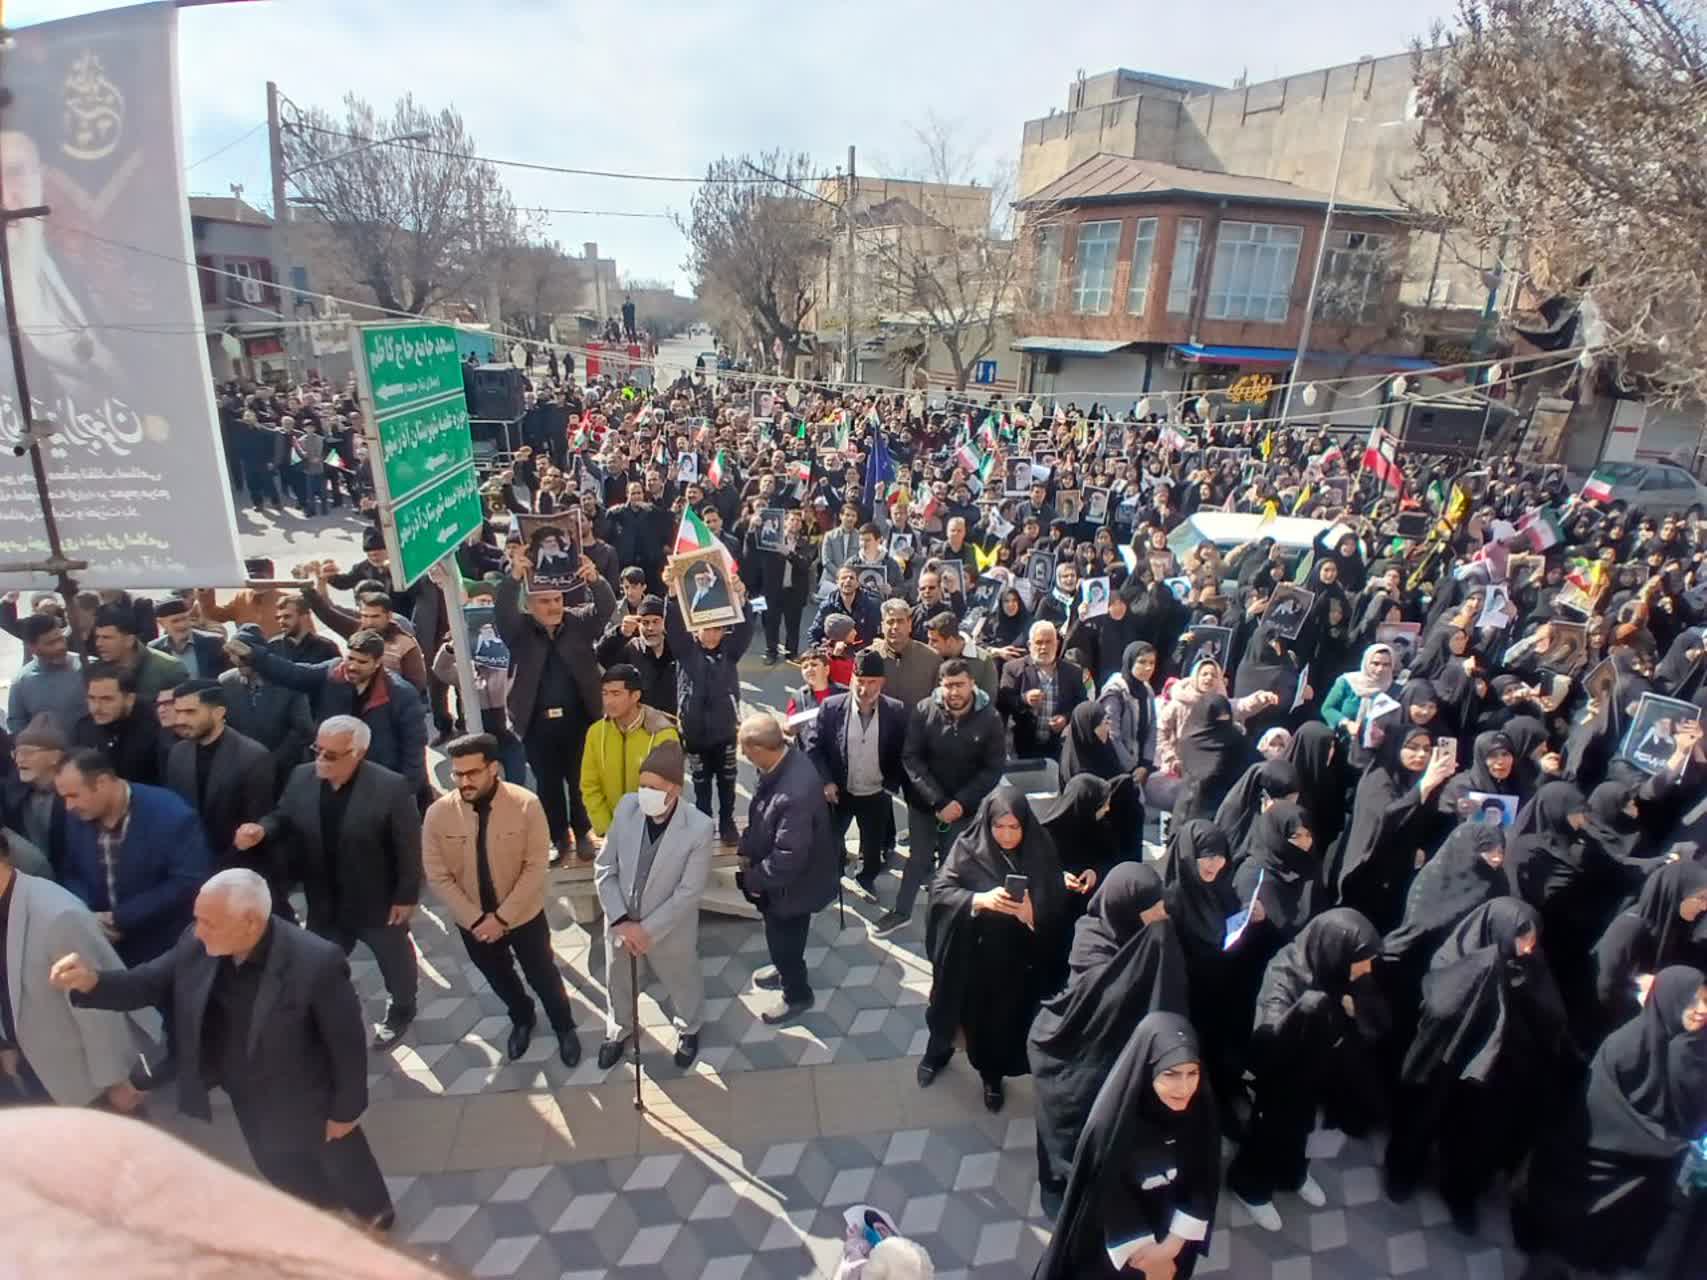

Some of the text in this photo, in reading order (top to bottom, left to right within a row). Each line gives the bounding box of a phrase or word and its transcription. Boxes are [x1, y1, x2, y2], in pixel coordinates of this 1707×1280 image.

[397, 333, 414, 371] حاج
[415, 333, 434, 368] جامع
[435, 337, 456, 362] مسجد
